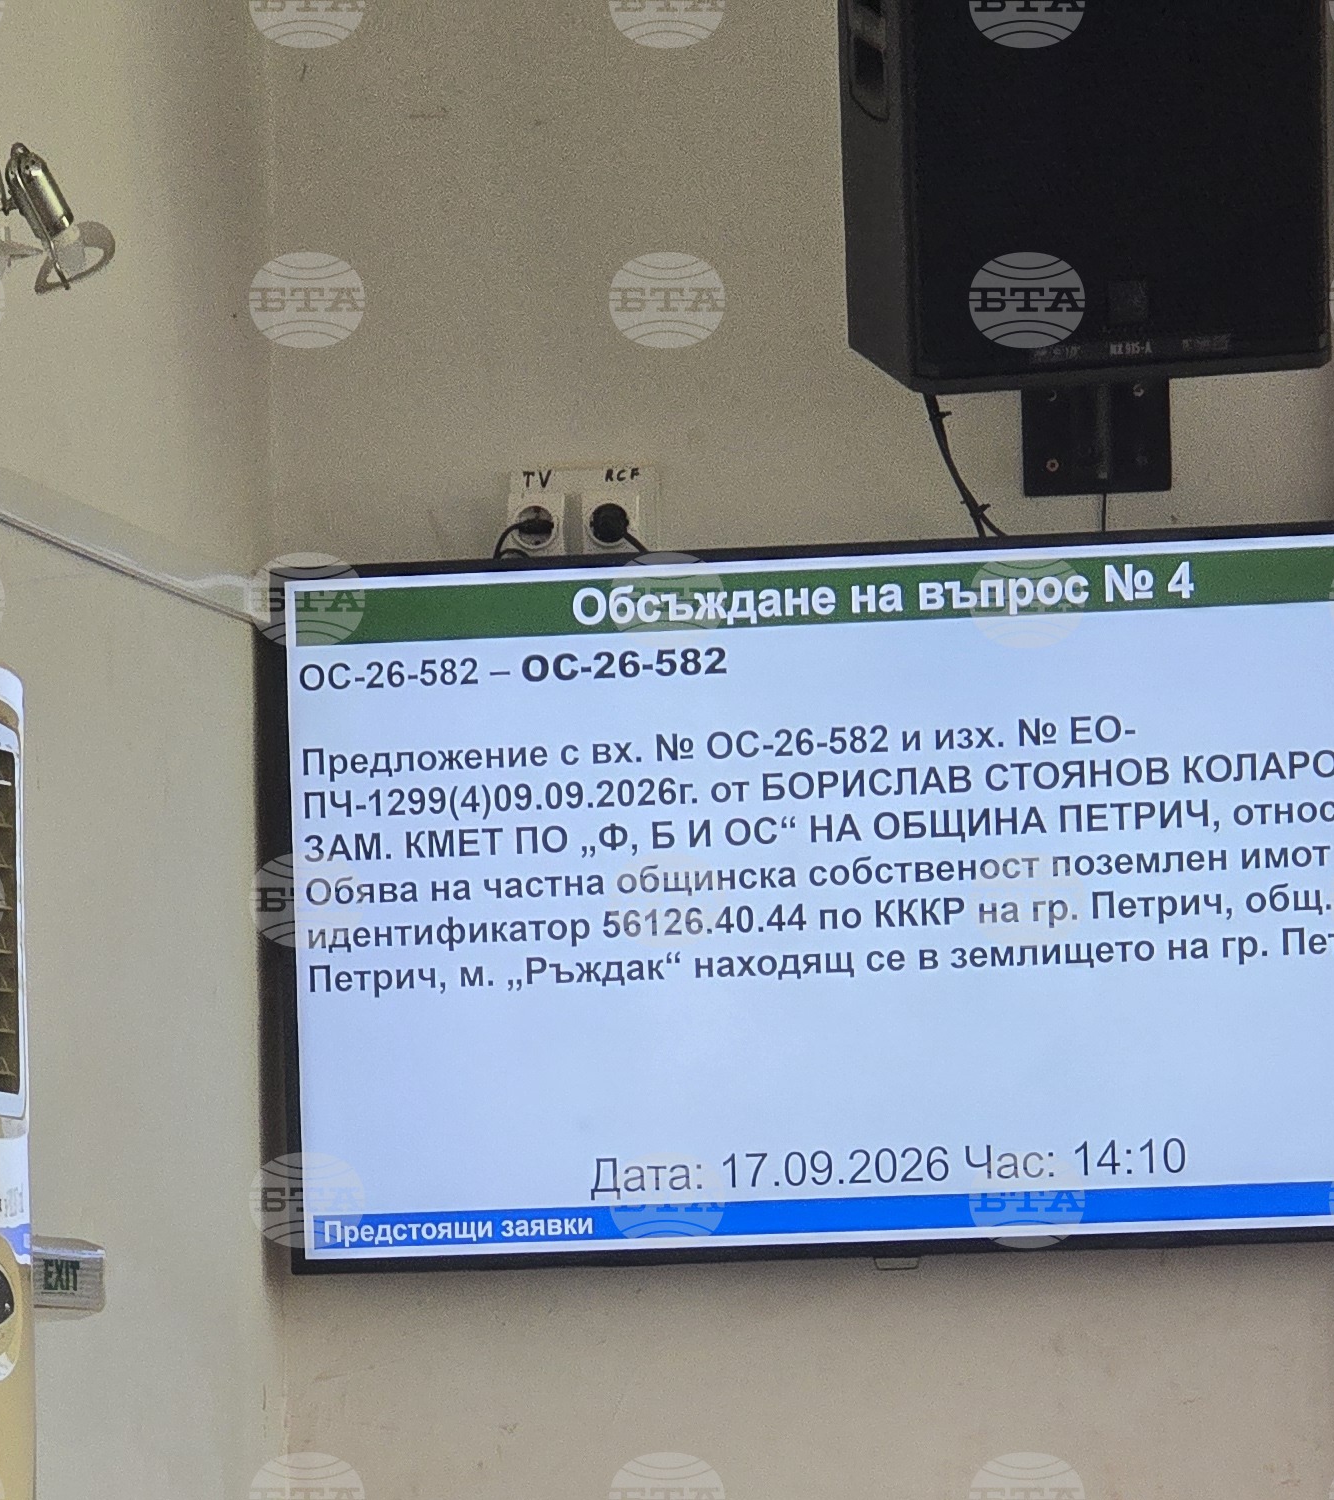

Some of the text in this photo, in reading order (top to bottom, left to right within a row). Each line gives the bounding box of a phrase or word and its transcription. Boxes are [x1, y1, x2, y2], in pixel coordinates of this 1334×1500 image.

[523, 469, 553, 488] TV
[605, 467, 640, 482] RCF
[573, 562, 1193, 625] Обсъждане на въпрос № 4
[299, 657, 478, 691] ОС-26-582
[522, 647, 727, 682] ОС-26-582
[303, 715, 1135, 777] Предложение с вх. № ОС-26-582 и изх. № ЕО-
[304, 780, 697, 819] ПЧ-1299(4)09.09.2026г.
[711, 781, 750, 803] от
[762, 765, 972, 801] БОРИСЛАВ
[985, 757, 1169, 791] СТОЯНОВ
[304, 832, 391, 862] ЗАМ.
[405, 828, 503, 859] КМЕТ
[516, 825, 567, 854] ПО
[652, 821, 675, 849] Б
[689, 819, 711, 848] И
[810, 813, 862, 843] НА
[874, 806, 1047, 843] ОБЩИНА
[1060, 799, 1219, 833] ПЕТРИЧ,
[306, 876, 418, 905] Обява
[431, 880, 471, 901] на
[484, 874, 604, 899] частна
[617, 864, 796, 896] общинска
[809, 856, 1039, 886] собственост
[1052, 849, 1227, 877] поземлен
[1241, 845, 1331, 870] имот
[308, 883, 1332, 953] идентификатор 56126.40.44 по КККР на гр. Петрич, общ.
[309, 964, 446, 998] Петрич,
[460, 966, 493, 987] м.
[695, 952, 854, 980] находящ
[866, 950, 905, 972] се
[919, 949, 938, 970] в
[951, 940, 1154, 969] землището
[1168, 938, 1208, 960] на
[1222, 936, 1267, 965] гр.
[591, 1138, 1185, 1201] Дата: 17.09.2026 Час: 14:10
[325, 1218, 592, 1247] Предстоящи заявки
[43, 1259, 80, 1291] EXIT
